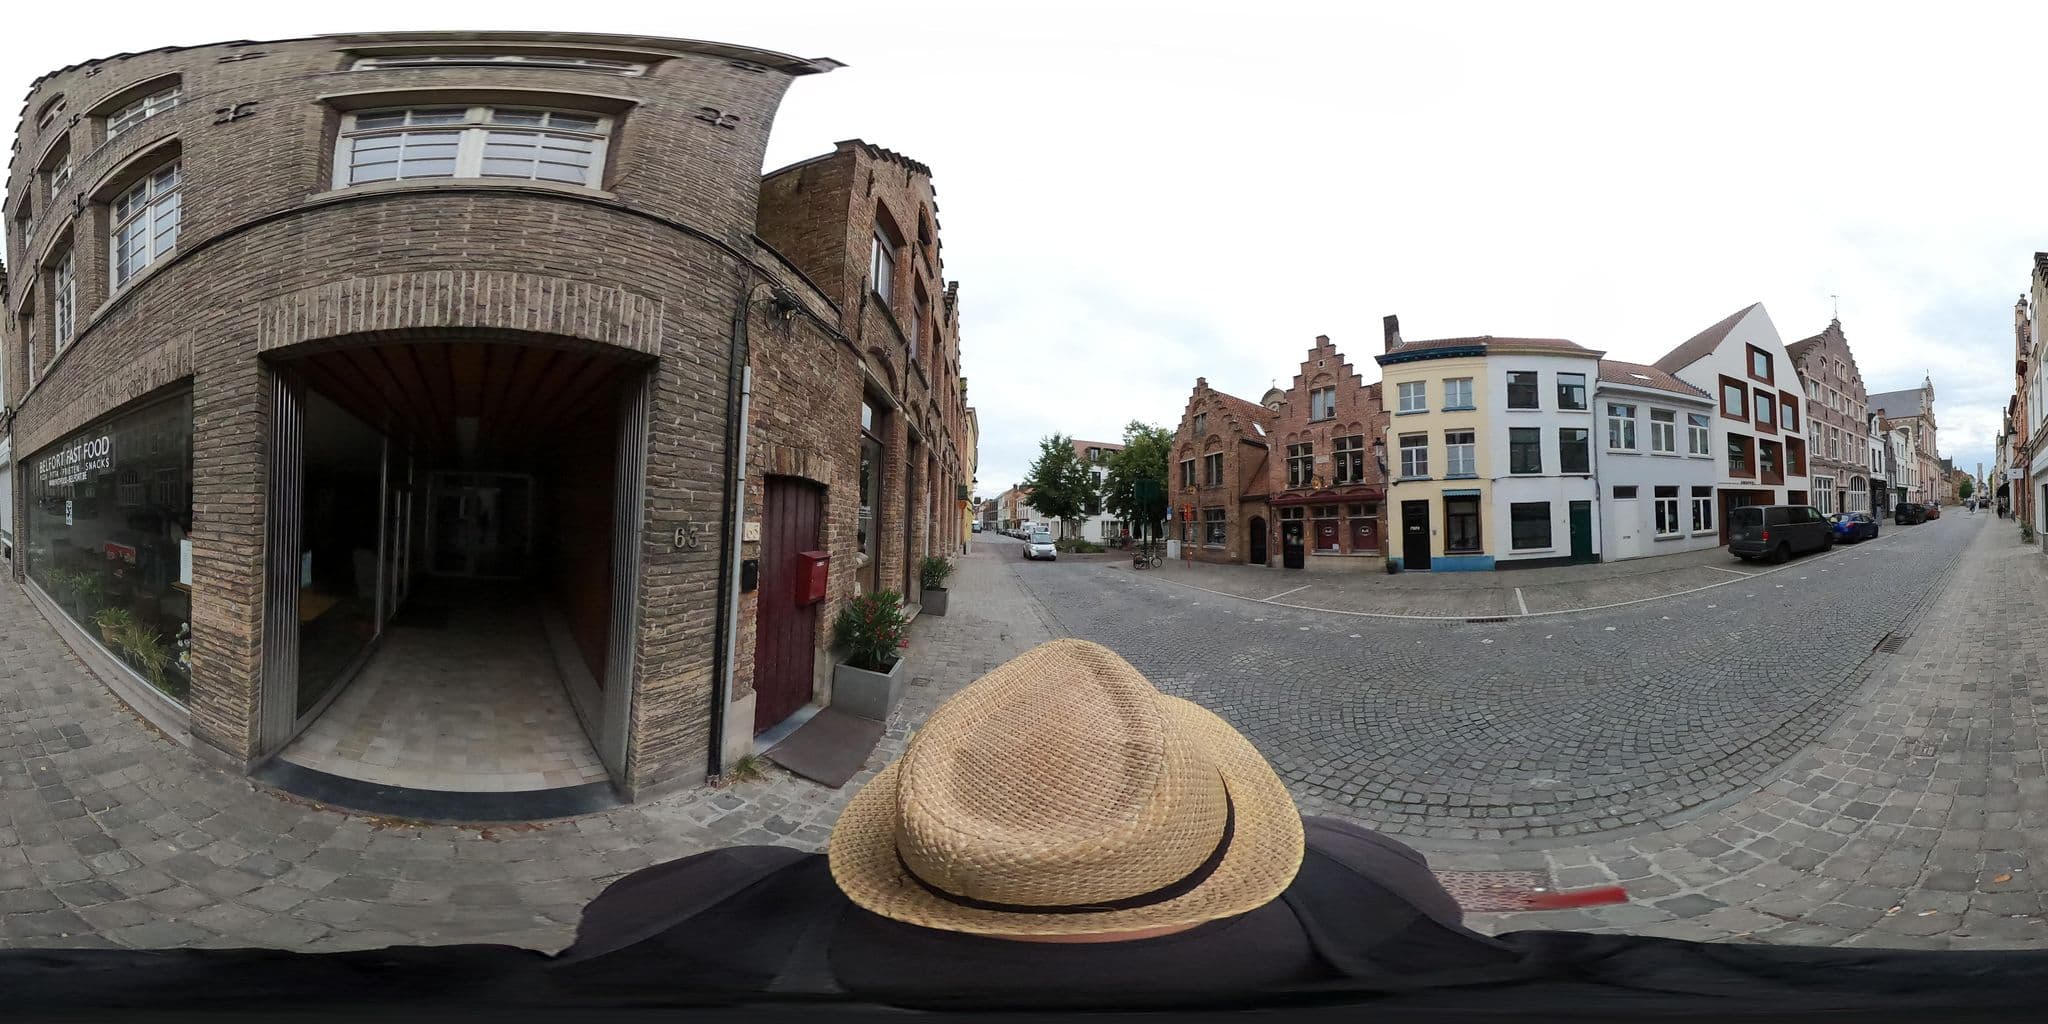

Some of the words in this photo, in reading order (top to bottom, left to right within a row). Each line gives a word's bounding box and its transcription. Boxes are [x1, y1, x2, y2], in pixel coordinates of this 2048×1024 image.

[40, 451, 65, 474] BELFORT
[66, 445, 82, 466] FAST
[83, 436, 109, 461] FOOD
[85, 457, 110, 471] SNACKS
[675, 526, 699, 549] 63
